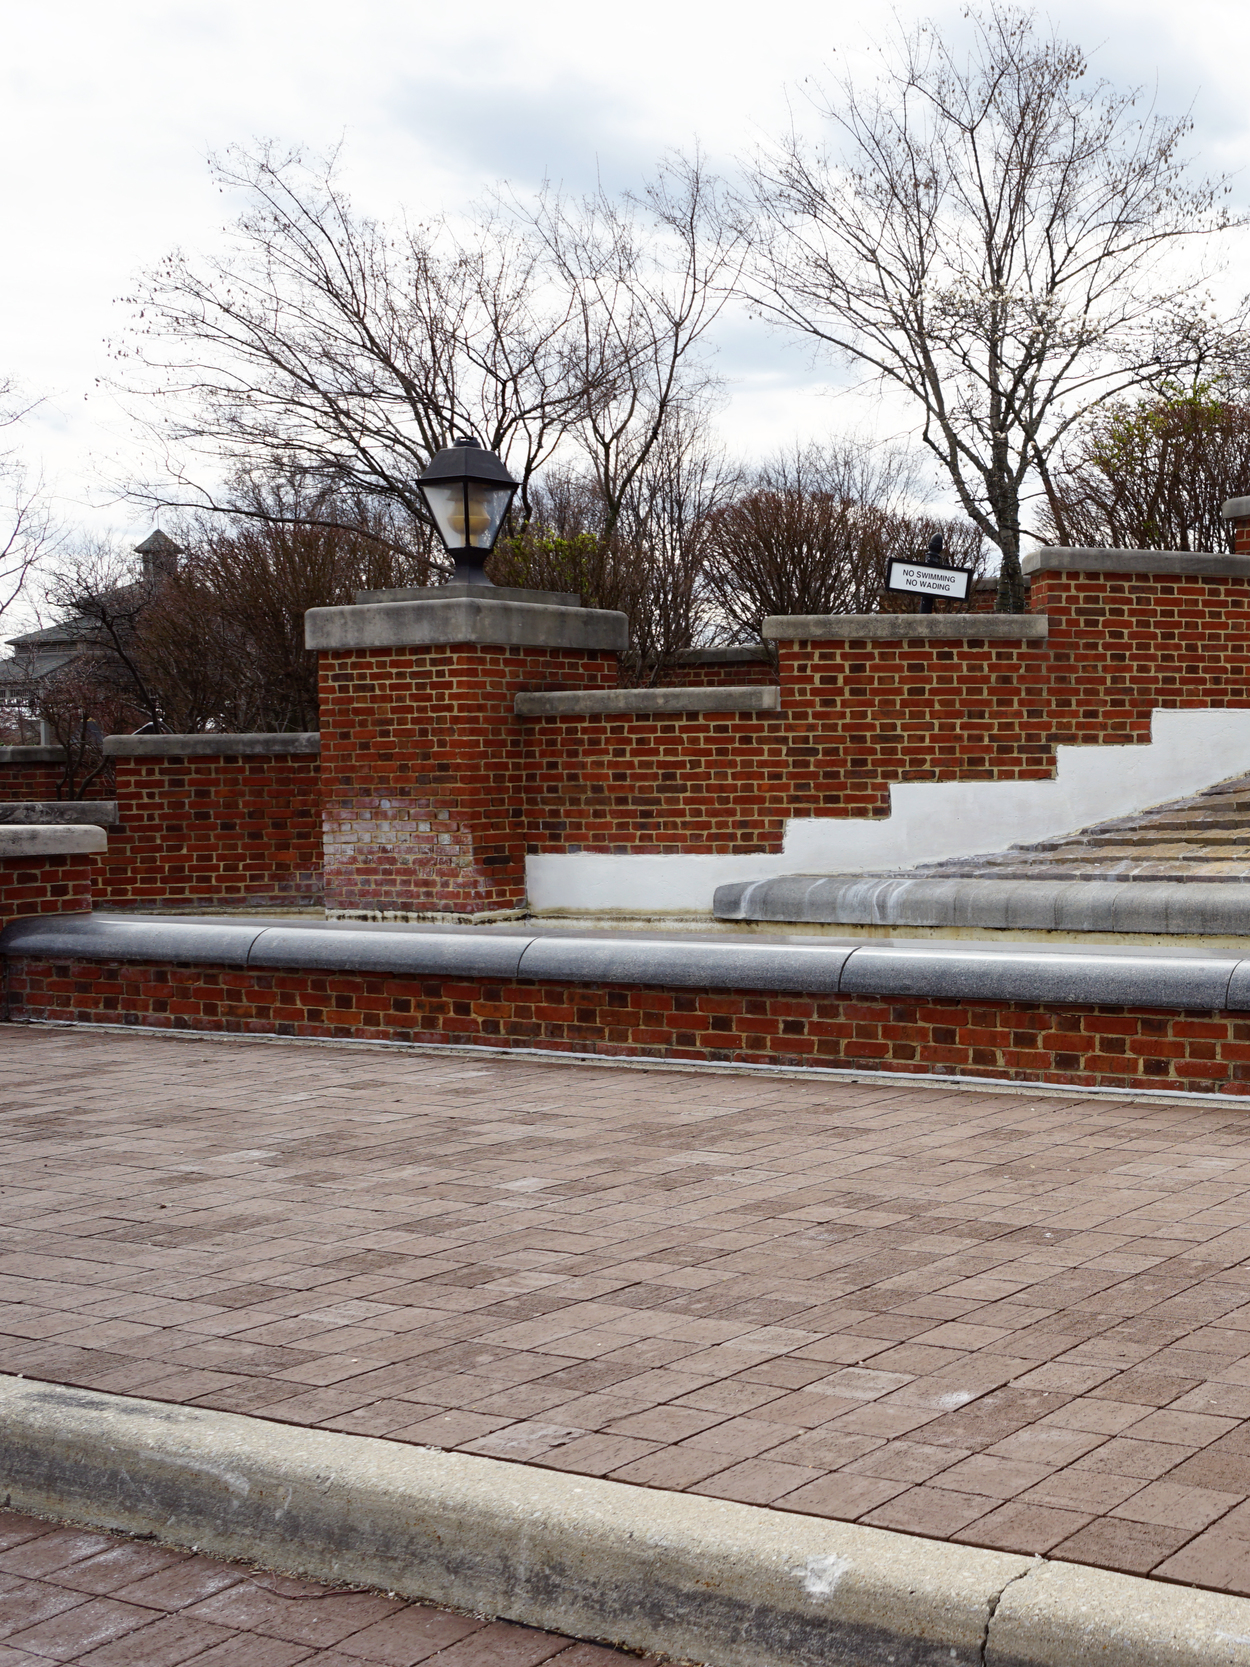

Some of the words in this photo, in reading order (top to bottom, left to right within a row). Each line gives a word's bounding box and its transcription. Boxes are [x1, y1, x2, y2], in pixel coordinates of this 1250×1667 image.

[902, 569, 915, 577] NO
[916, 571, 956, 583] SWIMMING
[905, 578, 918, 586] NO
[919, 581, 951, 591] WADING
